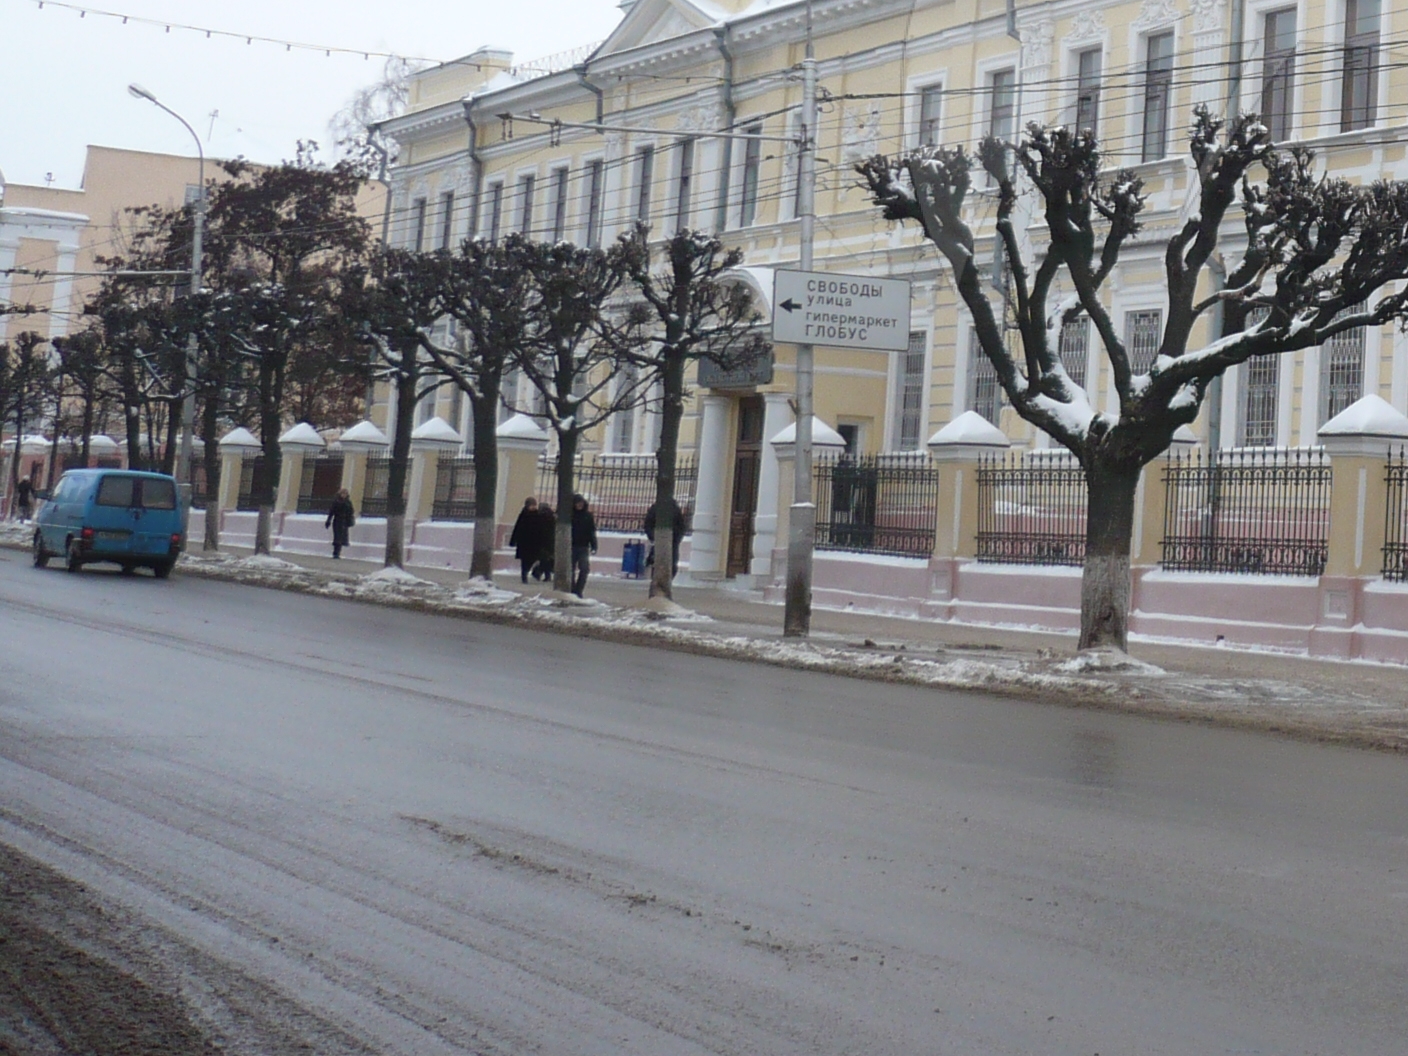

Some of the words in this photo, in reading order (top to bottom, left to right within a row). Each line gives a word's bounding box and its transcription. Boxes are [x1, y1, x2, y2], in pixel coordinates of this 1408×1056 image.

[807, 280, 882, 297] СВОБОДЫ
[807, 295, 852, 307] улица
[805, 312, 898, 328] гипермаркет
[805, 325, 868, 341] ГЛОБУС
